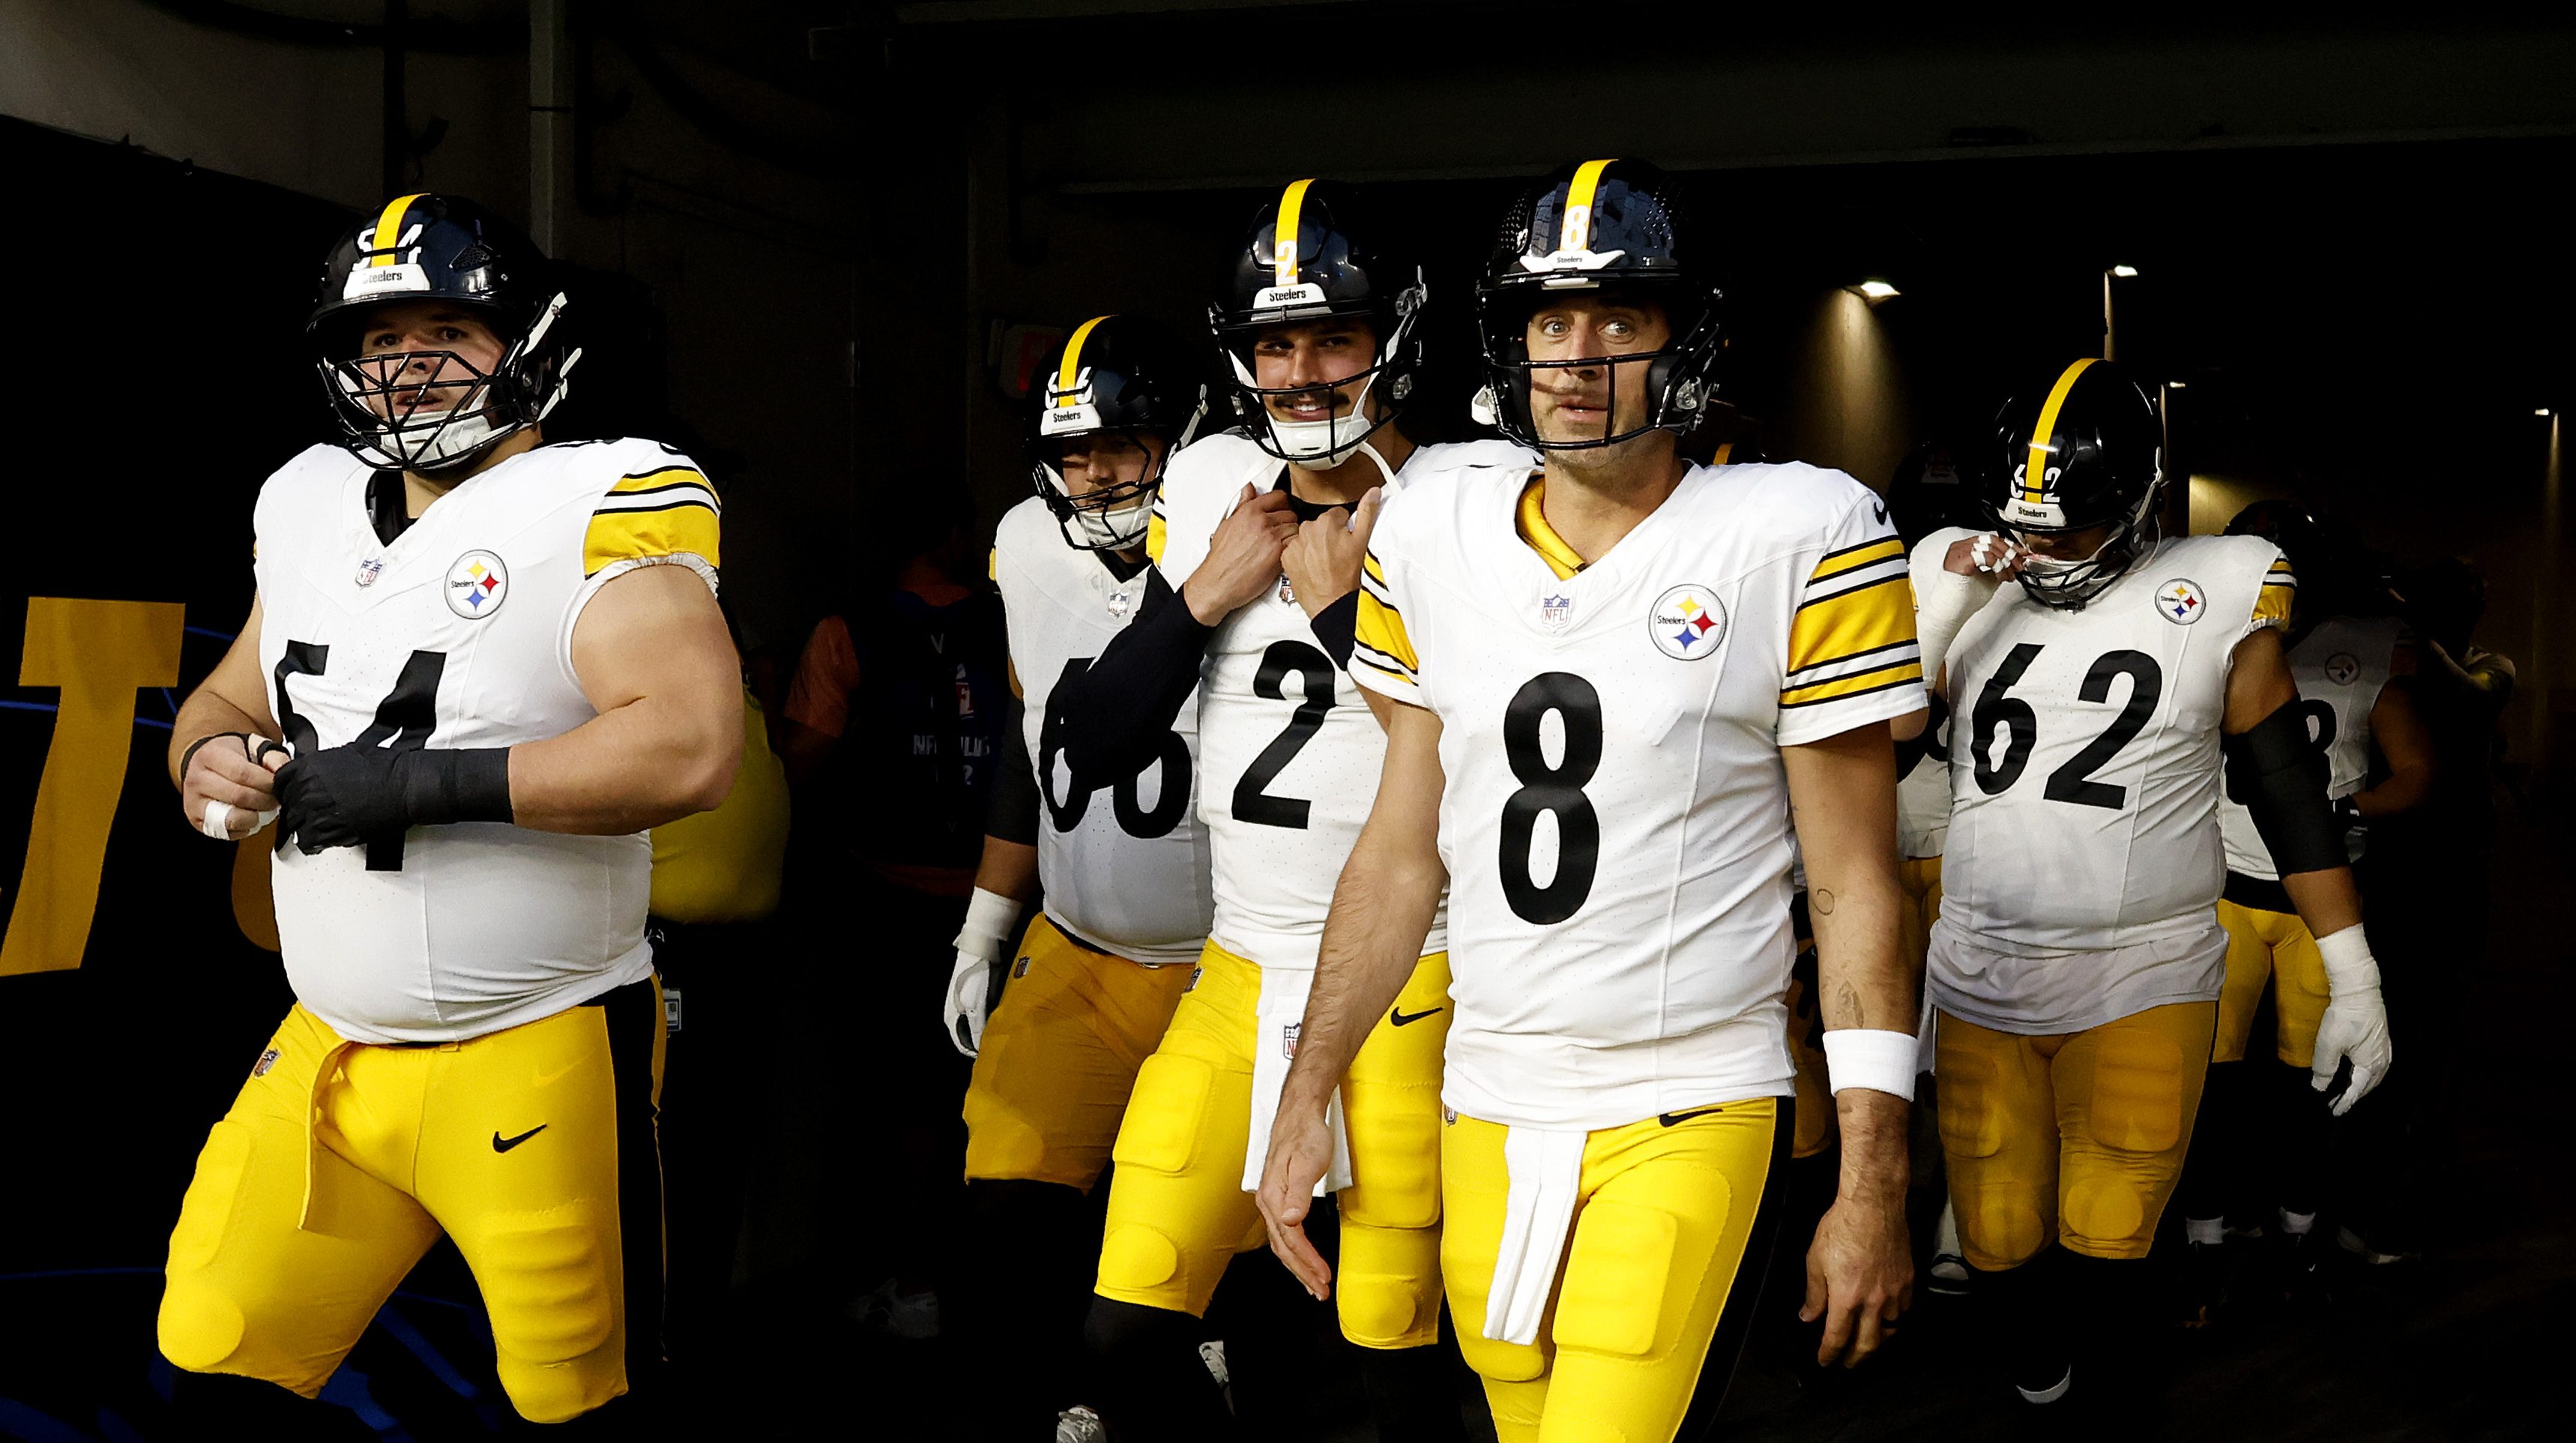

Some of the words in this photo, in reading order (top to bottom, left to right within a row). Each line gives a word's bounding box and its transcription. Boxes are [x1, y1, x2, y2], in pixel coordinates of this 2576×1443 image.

[1561, 205, 1590, 251] 8
[1276, 240, 1297, 285] 2
[1557, 256, 1583, 264] Steelers
[1269, 288, 1306, 302] Steelers
[1053, 411, 1081, 423] Steelers
[2010, 463, 2062, 503] 62
[2018, 506, 2048, 518] Steelers
[450, 579, 474, 588] Steelers
[1544, 608, 1565, 622] NFL
[1656, 615, 1686, 625] Steelers
[1971, 642, 2162, 810] 62
[1231, 639, 1337, 830] 2
[1499, 671, 1603, 925] 8
